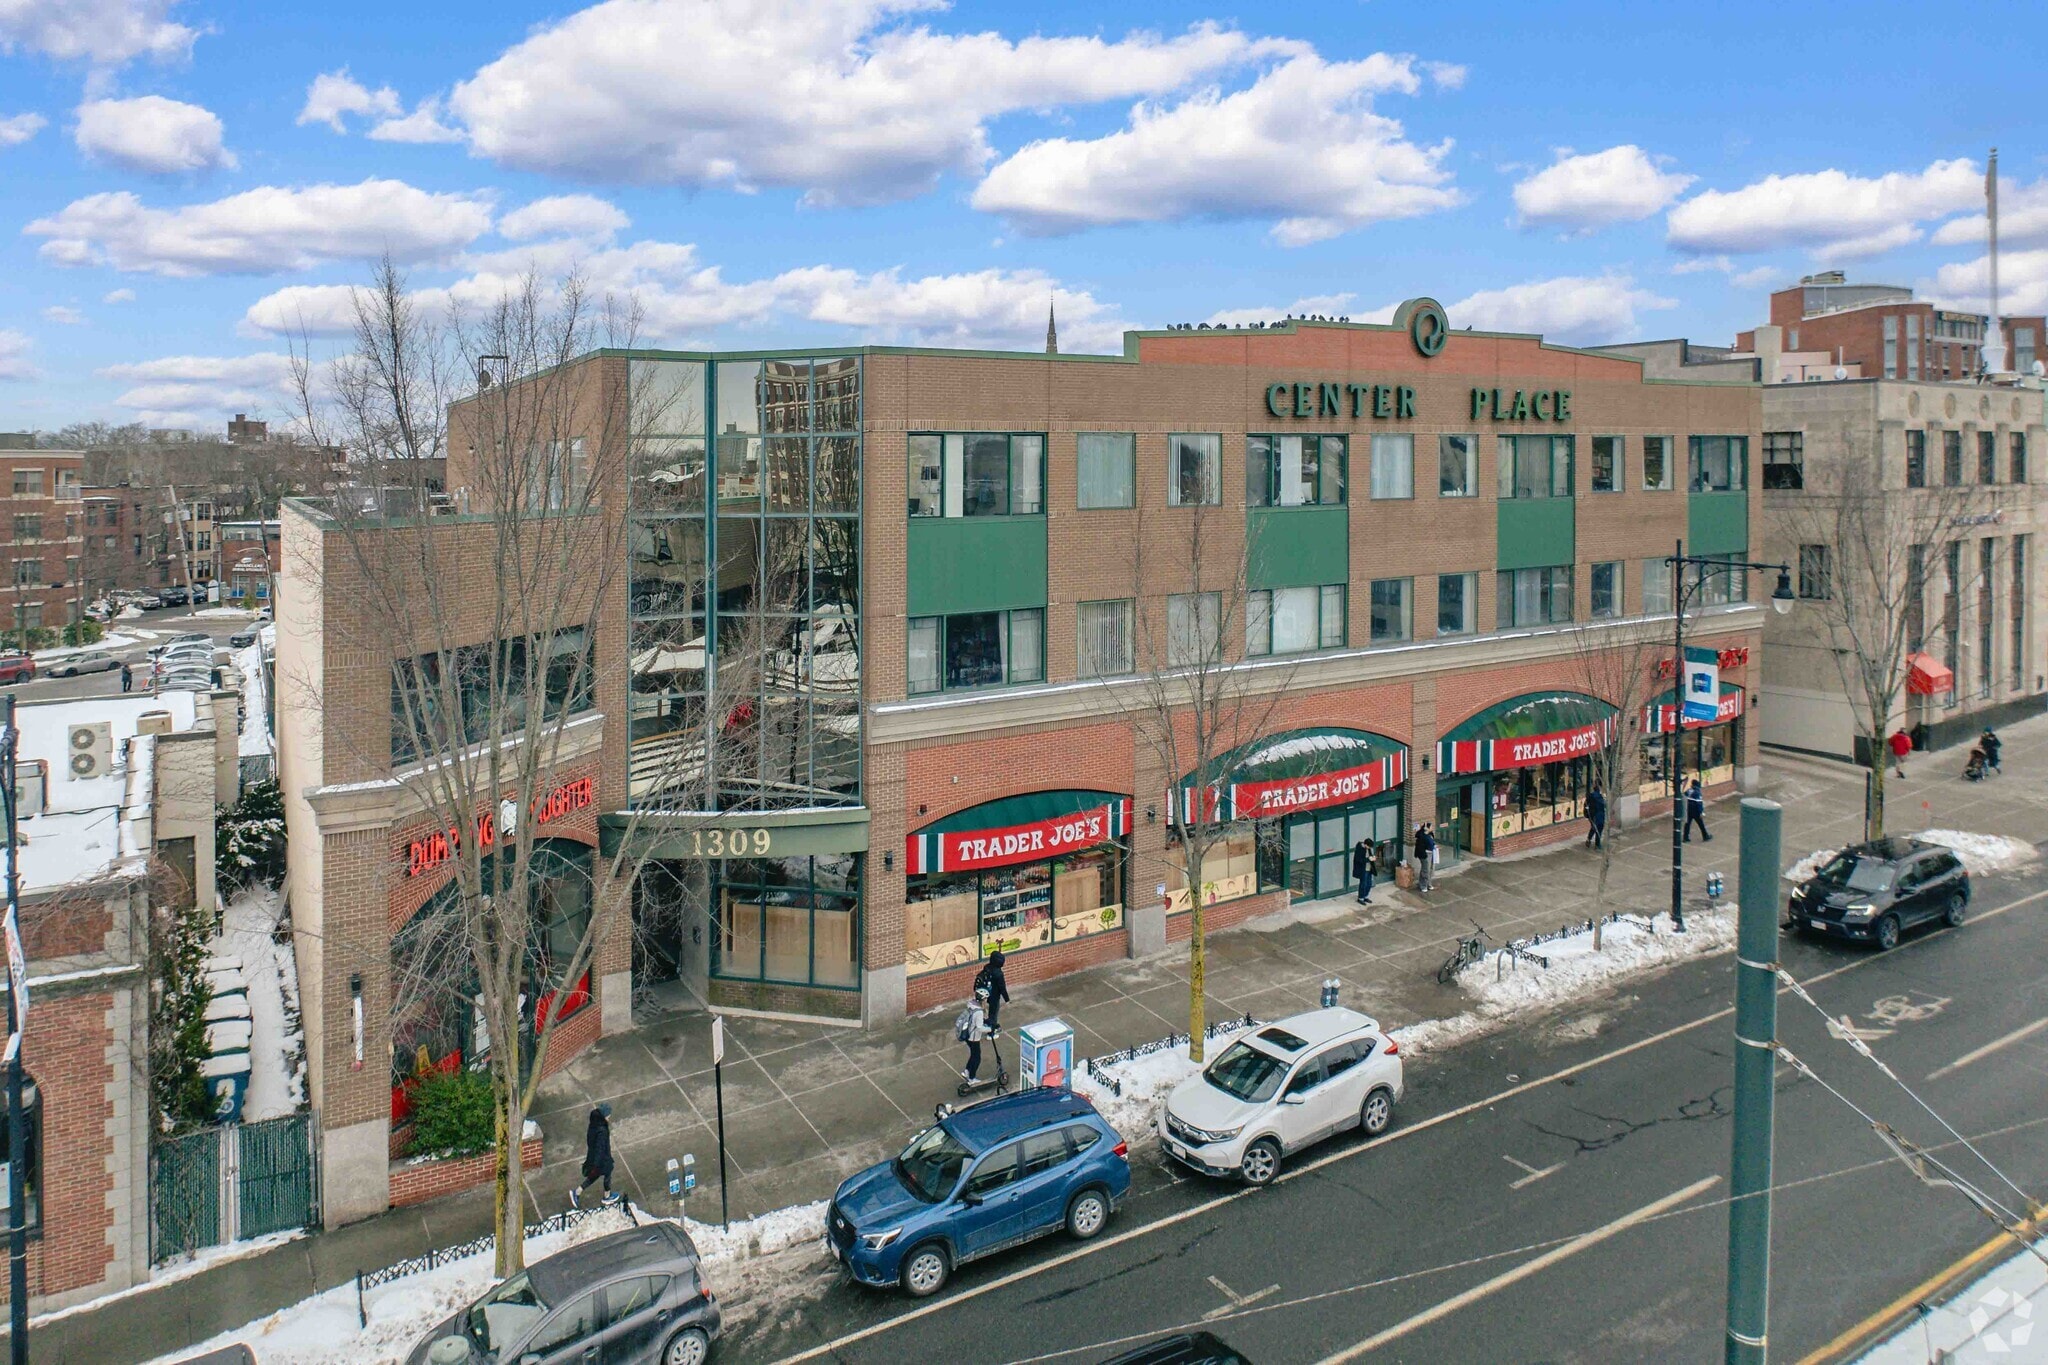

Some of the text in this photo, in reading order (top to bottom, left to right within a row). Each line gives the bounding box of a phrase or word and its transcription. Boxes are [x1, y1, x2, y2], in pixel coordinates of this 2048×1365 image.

[1266, 382, 1572, 421] CENTER PLACE
[1719, 699, 1735, 717] OE'S
[1512, 730, 1597, 761] TRADER JOE'S
[1260, 772, 1370, 809] TRADER JOE'S
[692, 828, 771, 857] 1309
[958, 816, 1101, 862] TRADER JOE'S
